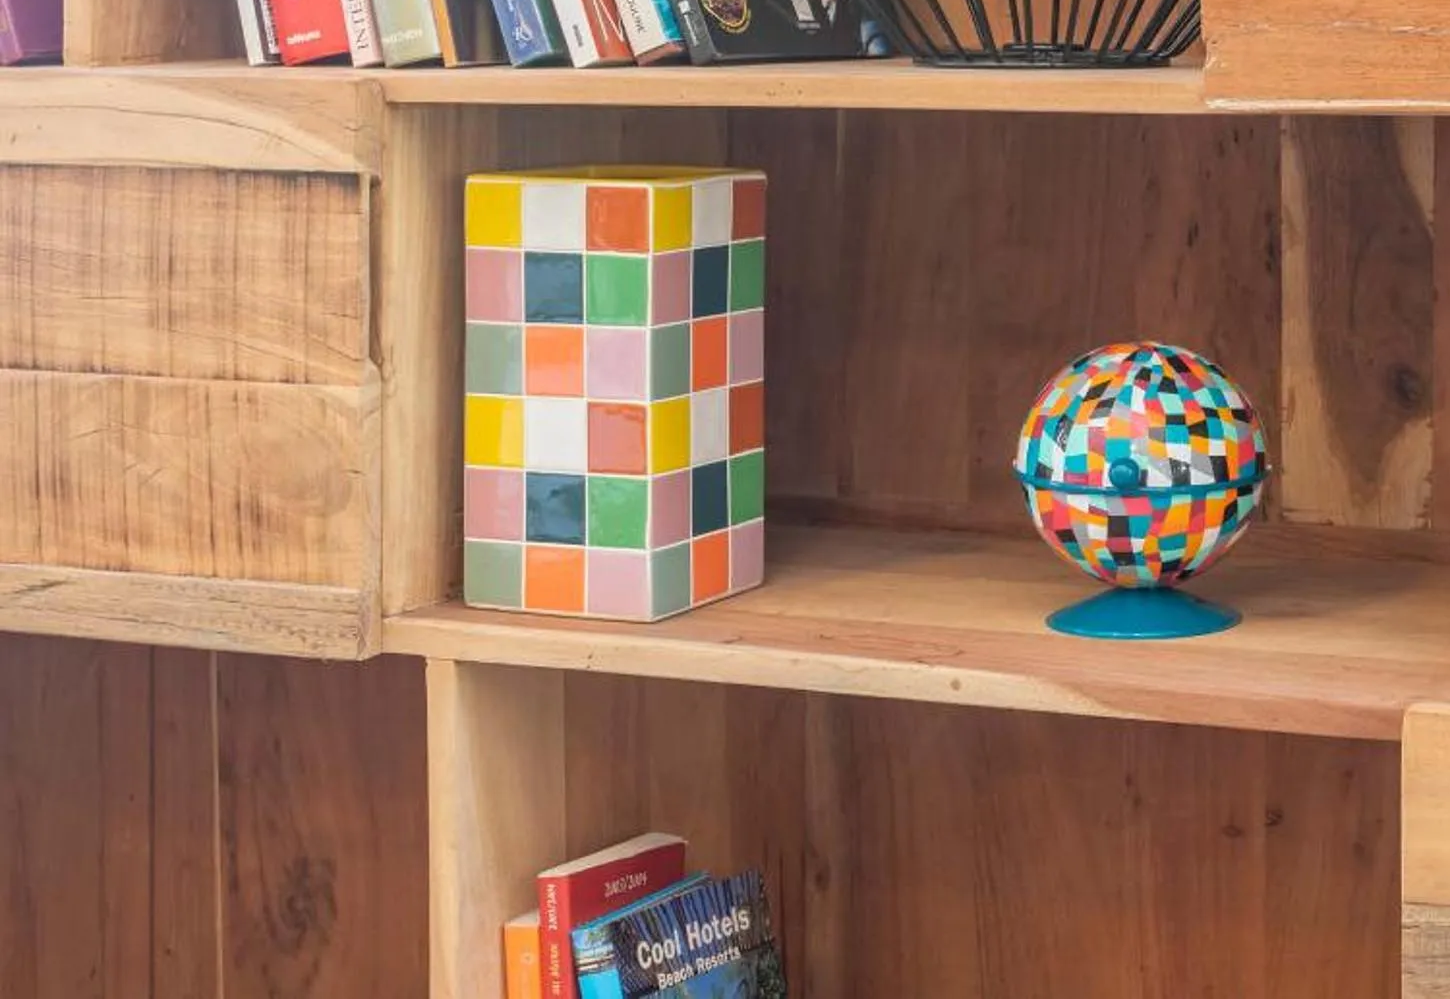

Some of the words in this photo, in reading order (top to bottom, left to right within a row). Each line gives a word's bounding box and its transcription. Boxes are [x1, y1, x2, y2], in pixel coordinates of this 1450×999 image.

[637, 930, 681, 969] Cool
[686, 907, 750, 950] Hotels
[658, 966, 694, 989] Beach
[696, 946, 741, 973] Resorts
